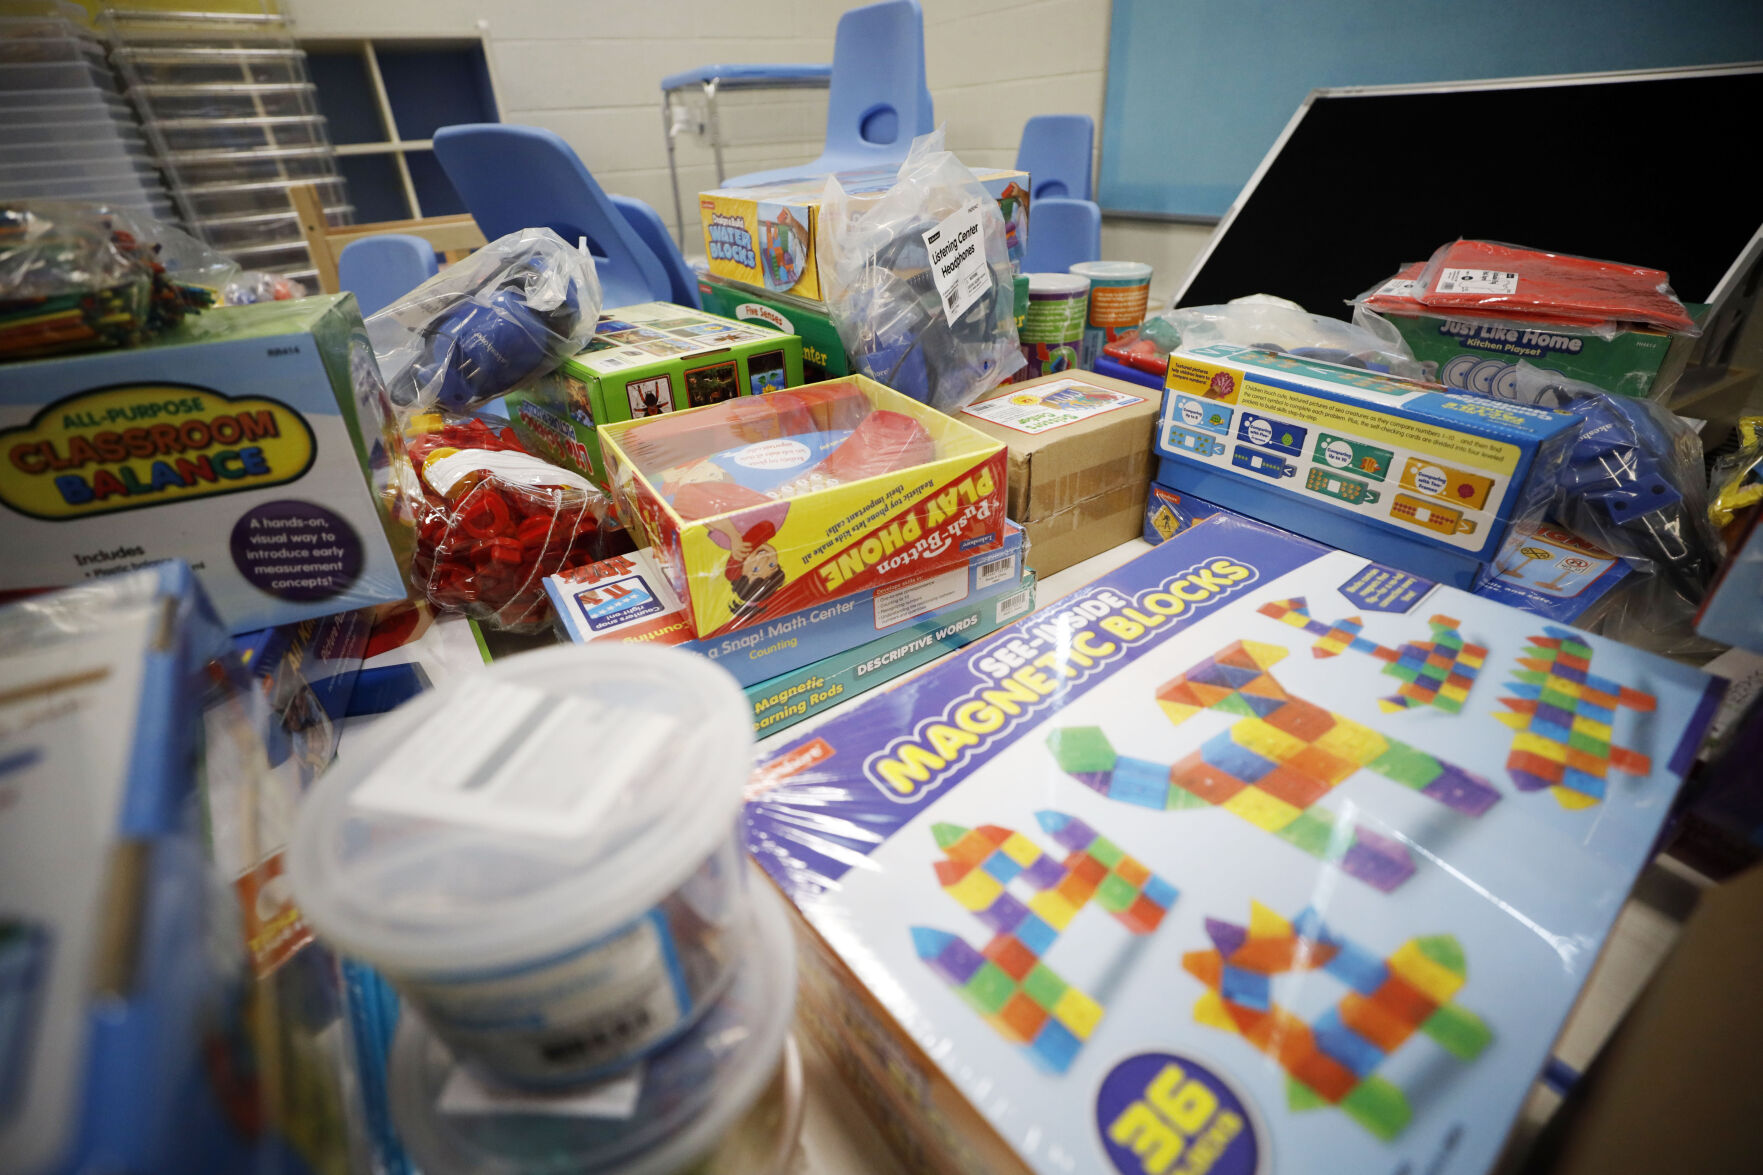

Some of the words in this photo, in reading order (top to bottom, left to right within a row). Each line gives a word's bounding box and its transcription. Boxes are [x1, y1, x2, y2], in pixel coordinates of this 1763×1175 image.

[709, 225, 752, 251] WATER
[932, 238, 958, 265] Listening
[958, 224, 979, 244] Center
[710, 241, 756, 269] BLOCKS
[941, 244, 976, 278] Headphones
[746, 305, 759, 317] Five
[760, 307, 783, 326] Senses
[1440, 319, 1478, 337] Just
[1480, 323, 1520, 343] Like
[1522, 329, 1583, 353] Home
[1466, 338, 1503, 351] Kitchen
[1505, 343, 1542, 357] Playset
[62, 397, 205, 430] ALL-PURPOSE
[1309, 400, 1329, 410] pictures
[1345, 410, 1369, 420] creatures
[1390, 421, 1415, 431] compare
[1415, 427, 1441, 438] numbers
[9, 409, 280, 475] CLASSROOM
[1405, 432, 1421, 441] cards
[55, 446, 272, 506] BALANCE
[886, 484, 905, 498] their
[903, 480, 935, 501] Realistic
[926, 466, 996, 528] PLAY
[846, 496, 886, 524] important
[867, 505, 890, 524] phone
[890, 498, 903, 510] toy
[250, 518, 260, 529] A
[263, 517, 329, 530] hands-on,
[826, 519, 846, 537] calls!
[852, 521, 867, 533] lets
[250, 532, 287, 545] visual
[290, 533, 318, 546] way
[321, 532, 336, 543] to
[813, 539, 835, 556] make
[835, 530, 852, 543] kids
[877, 499, 1000, 576] Push-Button
[74, 545, 145, 567] Includes
[246, 547, 309, 560] introduce
[312, 545, 344, 560] early
[801, 553, 814, 565] all
[817, 517, 922, 593] PHONE
[254, 561, 343, 575] measurement
[272, 575, 333, 591] concepts!
[607, 611, 626, 620] on!
[619, 606, 661, 622] Counters
[626, 605, 646, 614] right
[596, 618, 619, 630] snap
[709, 647, 720, 660] a
[721, 630, 764, 657] Snap!
[768, 616, 807, 640] Math
[809, 599, 856, 625] Center
[977, 590, 1123, 679] SEE-INSIDE
[749, 636, 799, 661] Counting
[856, 635, 934, 677] DESCRIPTIVE
[935, 615, 979, 642] WORDS
[877, 627, 1117, 795] MAGNETIC
[1112, 558, 1252, 648] BLOCKS
[754, 676, 825, 714] Magnetic
[753, 701, 808, 732] earning
[809, 683, 845, 707] Rods
[1108, 1060, 1221, 1168] 36
